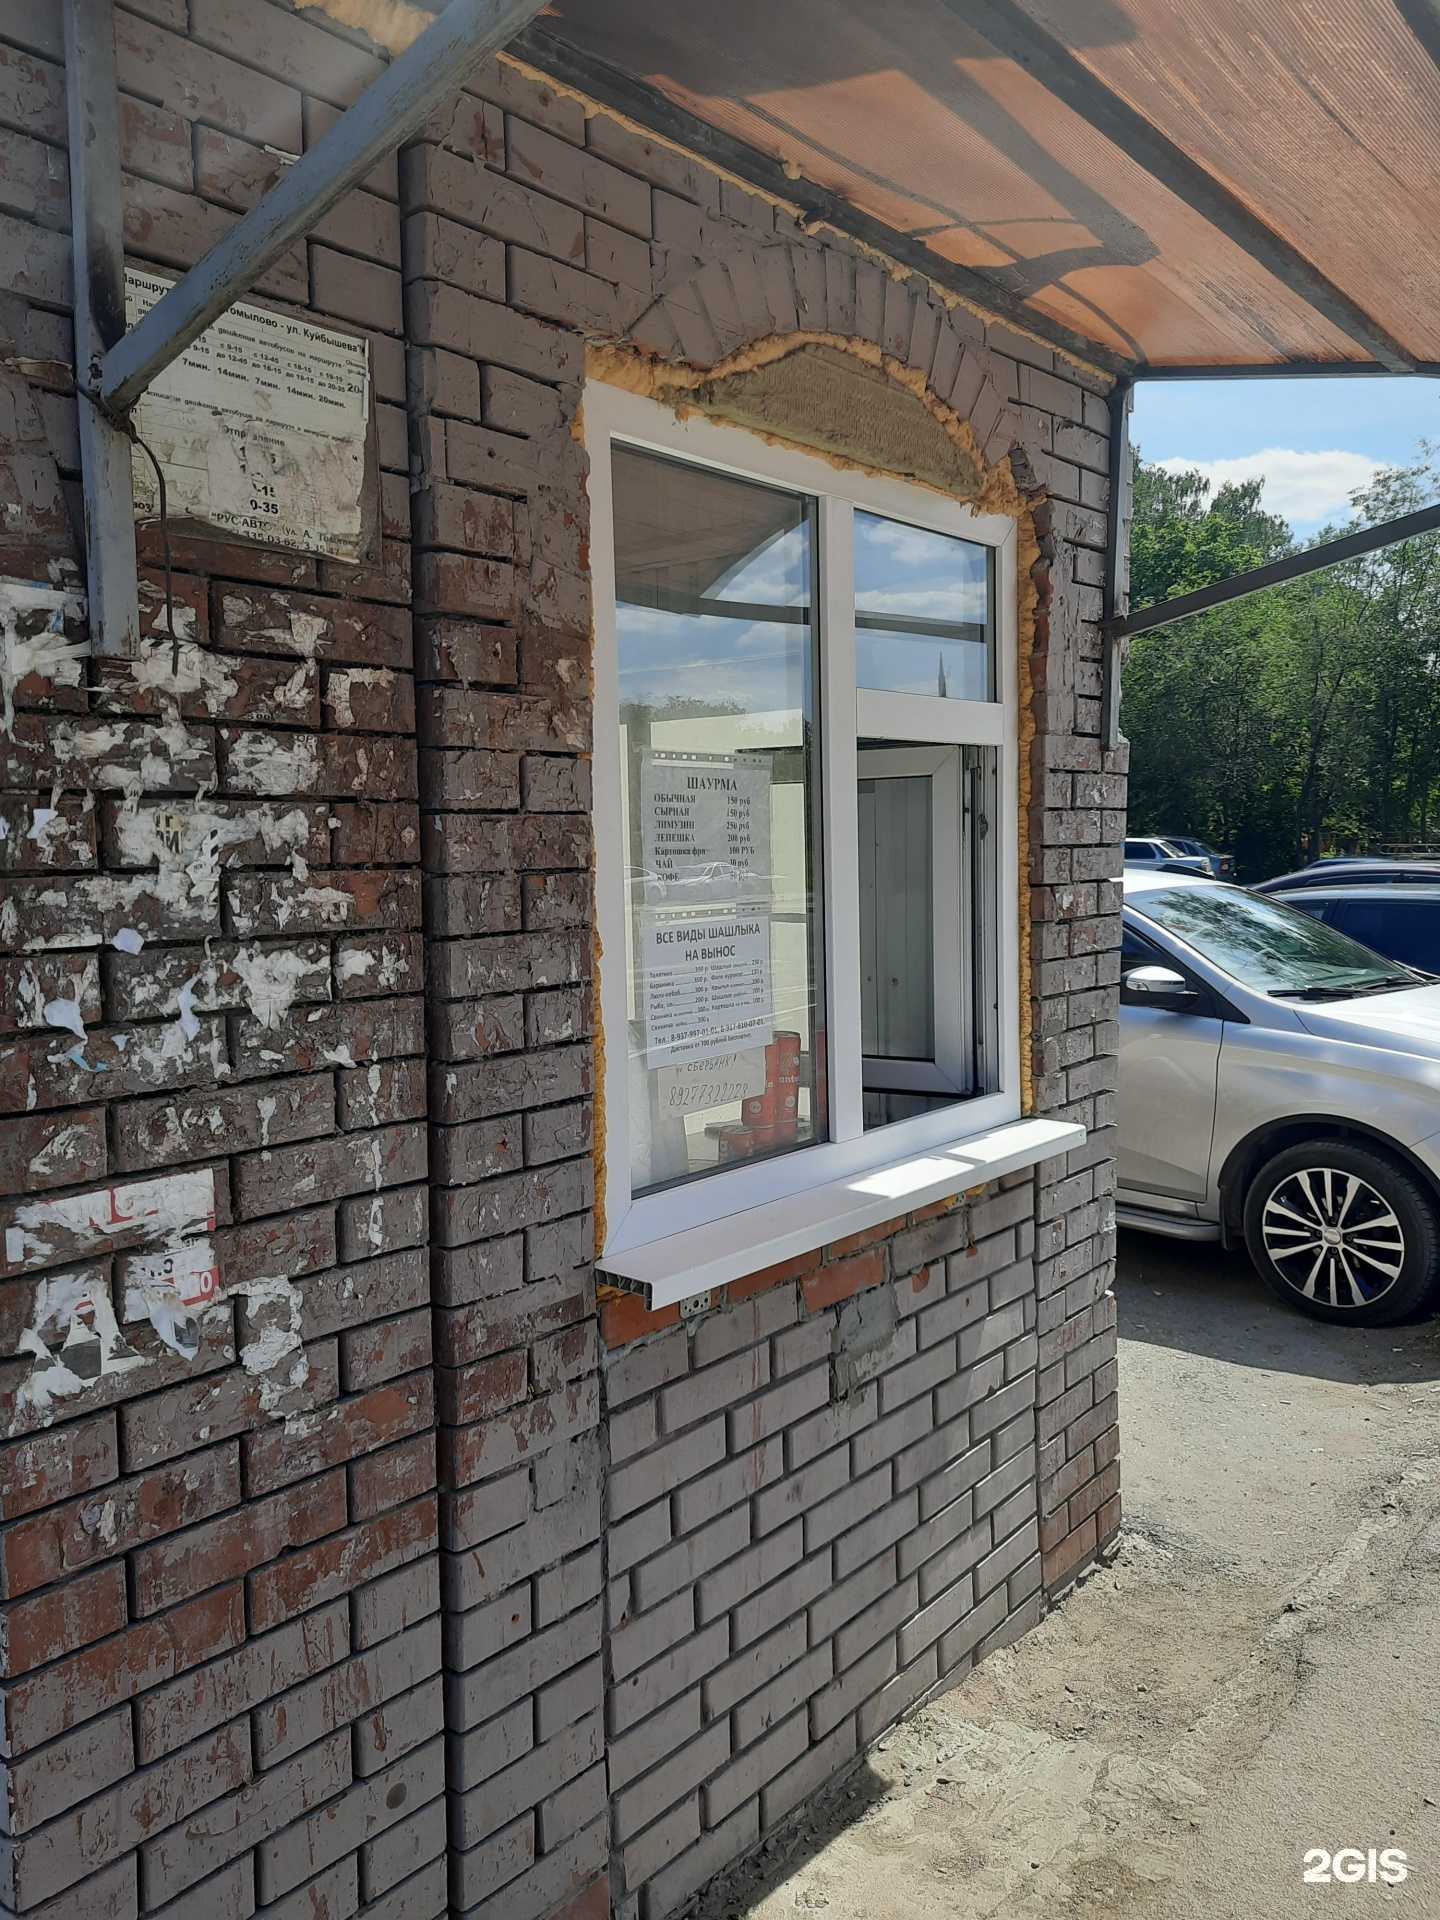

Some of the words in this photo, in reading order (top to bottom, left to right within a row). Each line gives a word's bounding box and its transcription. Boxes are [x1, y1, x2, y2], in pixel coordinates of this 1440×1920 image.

[225, 307, 278, 328] омылово
[687, 776, 738, 792] ШАУРМА
[654, 793, 696, 805] ОБЫЧНАЯ
[654, 807, 690, 817] СЫРНАЯ
[654, 833, 696, 843] ЛЕПЕШКА
[655, 857, 673, 869] ЧАЙ
[655, 931, 674, 945] ВСЕ
[676, 928, 706, 944] ВИДЫ
[708, 922, 761, 939] ШАШЛЫКА
[685, 949, 699, 962] НА
[701, 944, 736, 960] ВЫНОС
